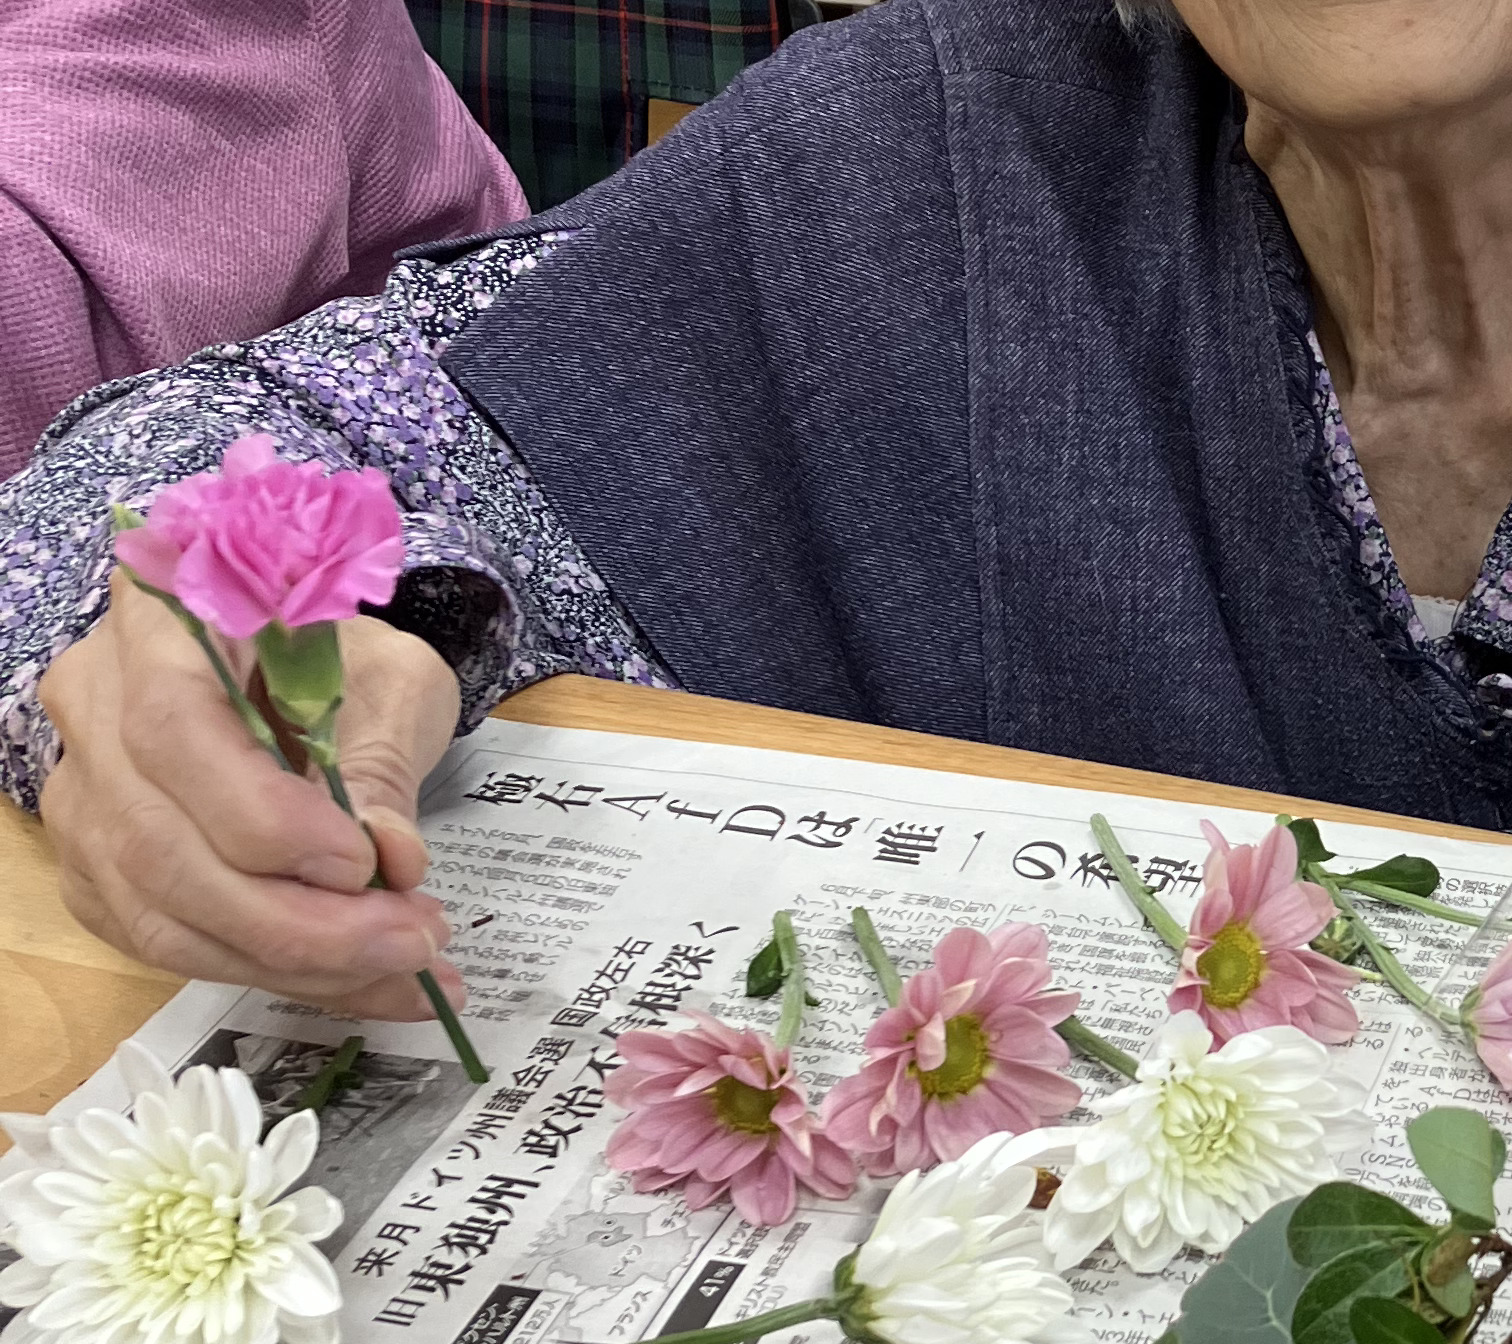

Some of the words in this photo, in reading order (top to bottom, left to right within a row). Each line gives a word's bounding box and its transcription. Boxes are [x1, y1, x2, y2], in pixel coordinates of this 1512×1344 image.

[352, 1036, 575, 1278] 来月ドイツ州議会選
[552, 936, 654, 1028] 国政左右
[372, 921, 740, 1327] 旧東独州、政治不信根深く
[608, 1244, 643, 1278] ドイツ
[695, 1263, 738, 1298] 41%
[607, 1290, 653, 1337] フランス
